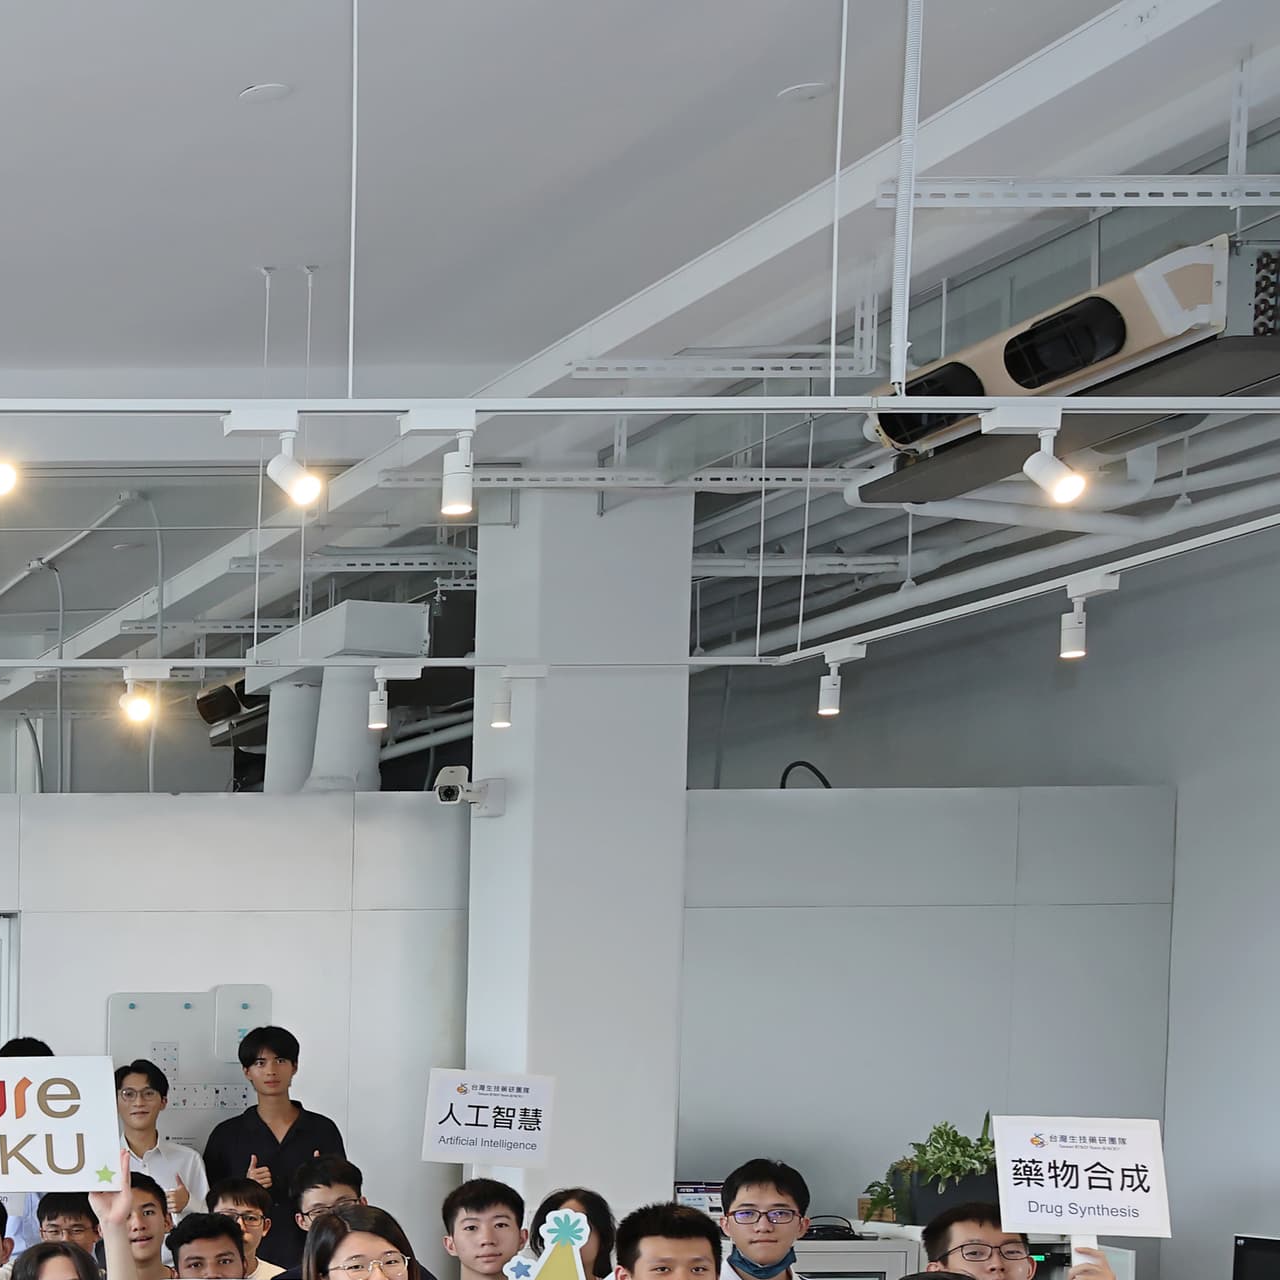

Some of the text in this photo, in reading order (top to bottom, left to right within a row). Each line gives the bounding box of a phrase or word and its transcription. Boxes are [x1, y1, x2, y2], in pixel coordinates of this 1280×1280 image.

[438, 1102, 543, 1131] 人工智慧
[438, 1135, 538, 1151] Artificial Intelligence
[1011, 1157, 1151, 1194] 藥物合成
[1027, 1200, 1140, 1218] Drug Synthesis
